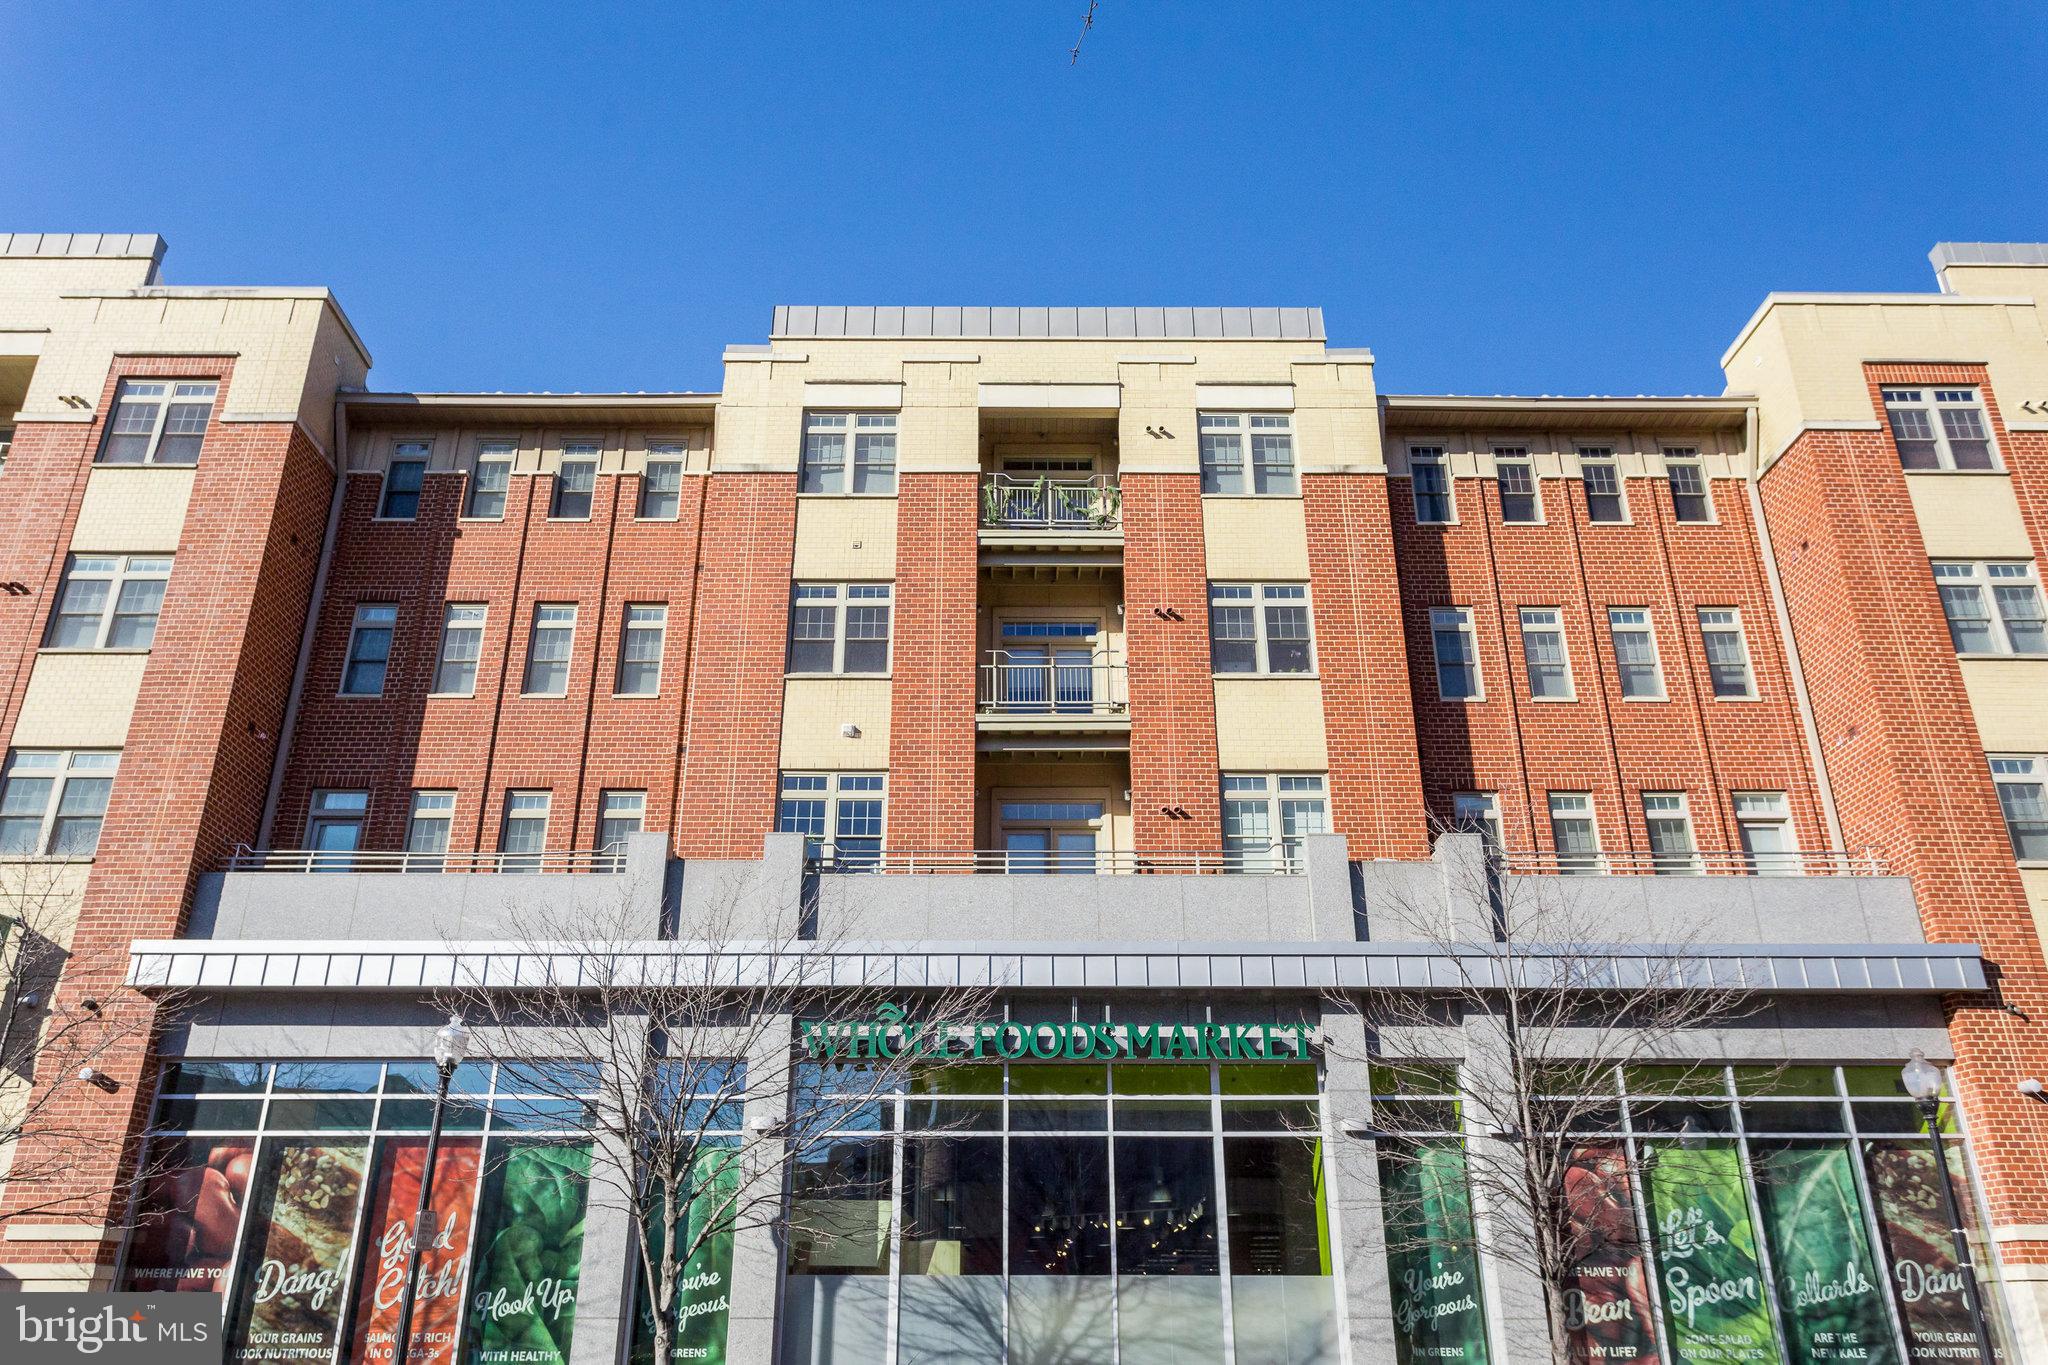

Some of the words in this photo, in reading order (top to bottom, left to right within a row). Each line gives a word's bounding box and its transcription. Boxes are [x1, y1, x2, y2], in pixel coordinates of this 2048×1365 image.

[800, 1021, 964, 1059] WHOLE
[972, 1021, 1118, 1059] FOODS
[1124, 1022, 1316, 1060] MARKET
[1659, 1206, 1726, 1261] Let's
[375, 1211, 456, 1269] God
[134, 1267, 173, 1278] WHERE
[175, 1267, 205, 1279] HAVE
[675, 1262, 721, 1291] ou're
[1584, 1267, 1614, 1277] HAVE
[253, 1248, 350, 1311] Dang!
[374, 1255, 467, 1310] Ctch!
[1404, 1262, 1464, 1302] You're
[1895, 1259, 1970, 1311] Dan
[474, 1281, 534, 1321] Hook
[536, 1277, 575, 1320] Up
[1665, 1267, 1757, 1328] Spoon
[1392, 1294, 1477, 1333] Gorgeous
[1562, 1288, 1633, 1330] Bean
[248, 1333, 279, 1344] YOUR
[281, 1333, 323, 1344] GRAINS
[412, 1332, 421, 1343] IS
[424, 1332, 451, 1343] RICH
[1684, 1334, 1717, 1345] SOME
[1718, 1334, 1752, 1345] SALAD
[1814, 1333, 1834, 1343] ARE
[1835, 1333, 1858, 1343] THE
[1915, 1332, 1944, 1343] YOUR
[235, 1348, 263, 1359] LOOK
[264, 1348, 333, 1359] NUTRITIOUS
[369, 1348, 381, 1359] IN
[384, 1347, 440, 1360] OGA-3s
[480, 1351, 508, 1361] WITH
[511, 1351, 561, 1362] HEALTHY
[670, 1348, 708, 1358] GREENS
[1428, 1347, 1464, 1357] GREENS
[1589, 1346, 1607, 1357] MY
[1610, 1346, 1637, 1358] LIFE?
[1680, 1349, 1697, 1359] ON
[1699, 1349, 1724, 1359] OUR
[1726, 1348, 1764, 1359] PLATES
[1811, 1348, 1837, 1358] NEW
[1838, 1348, 1867, 1359] KALE
